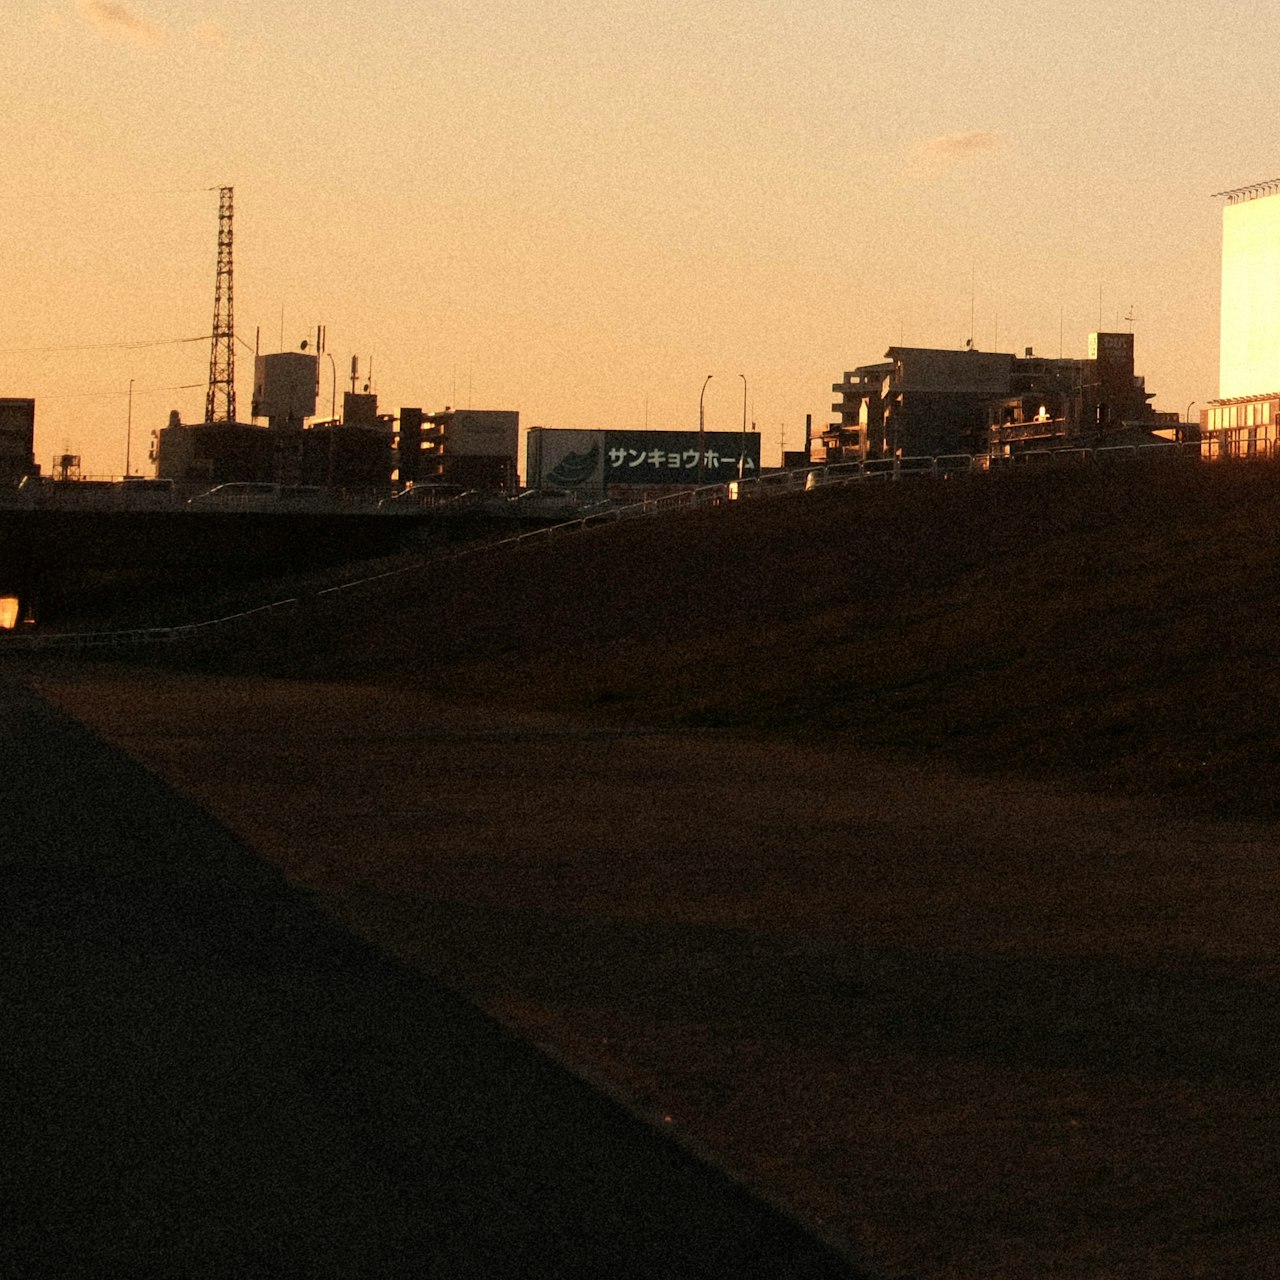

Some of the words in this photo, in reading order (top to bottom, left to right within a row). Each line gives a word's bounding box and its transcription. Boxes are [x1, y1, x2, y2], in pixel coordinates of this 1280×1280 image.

[608, 447, 755, 469] サンキョウホーム
